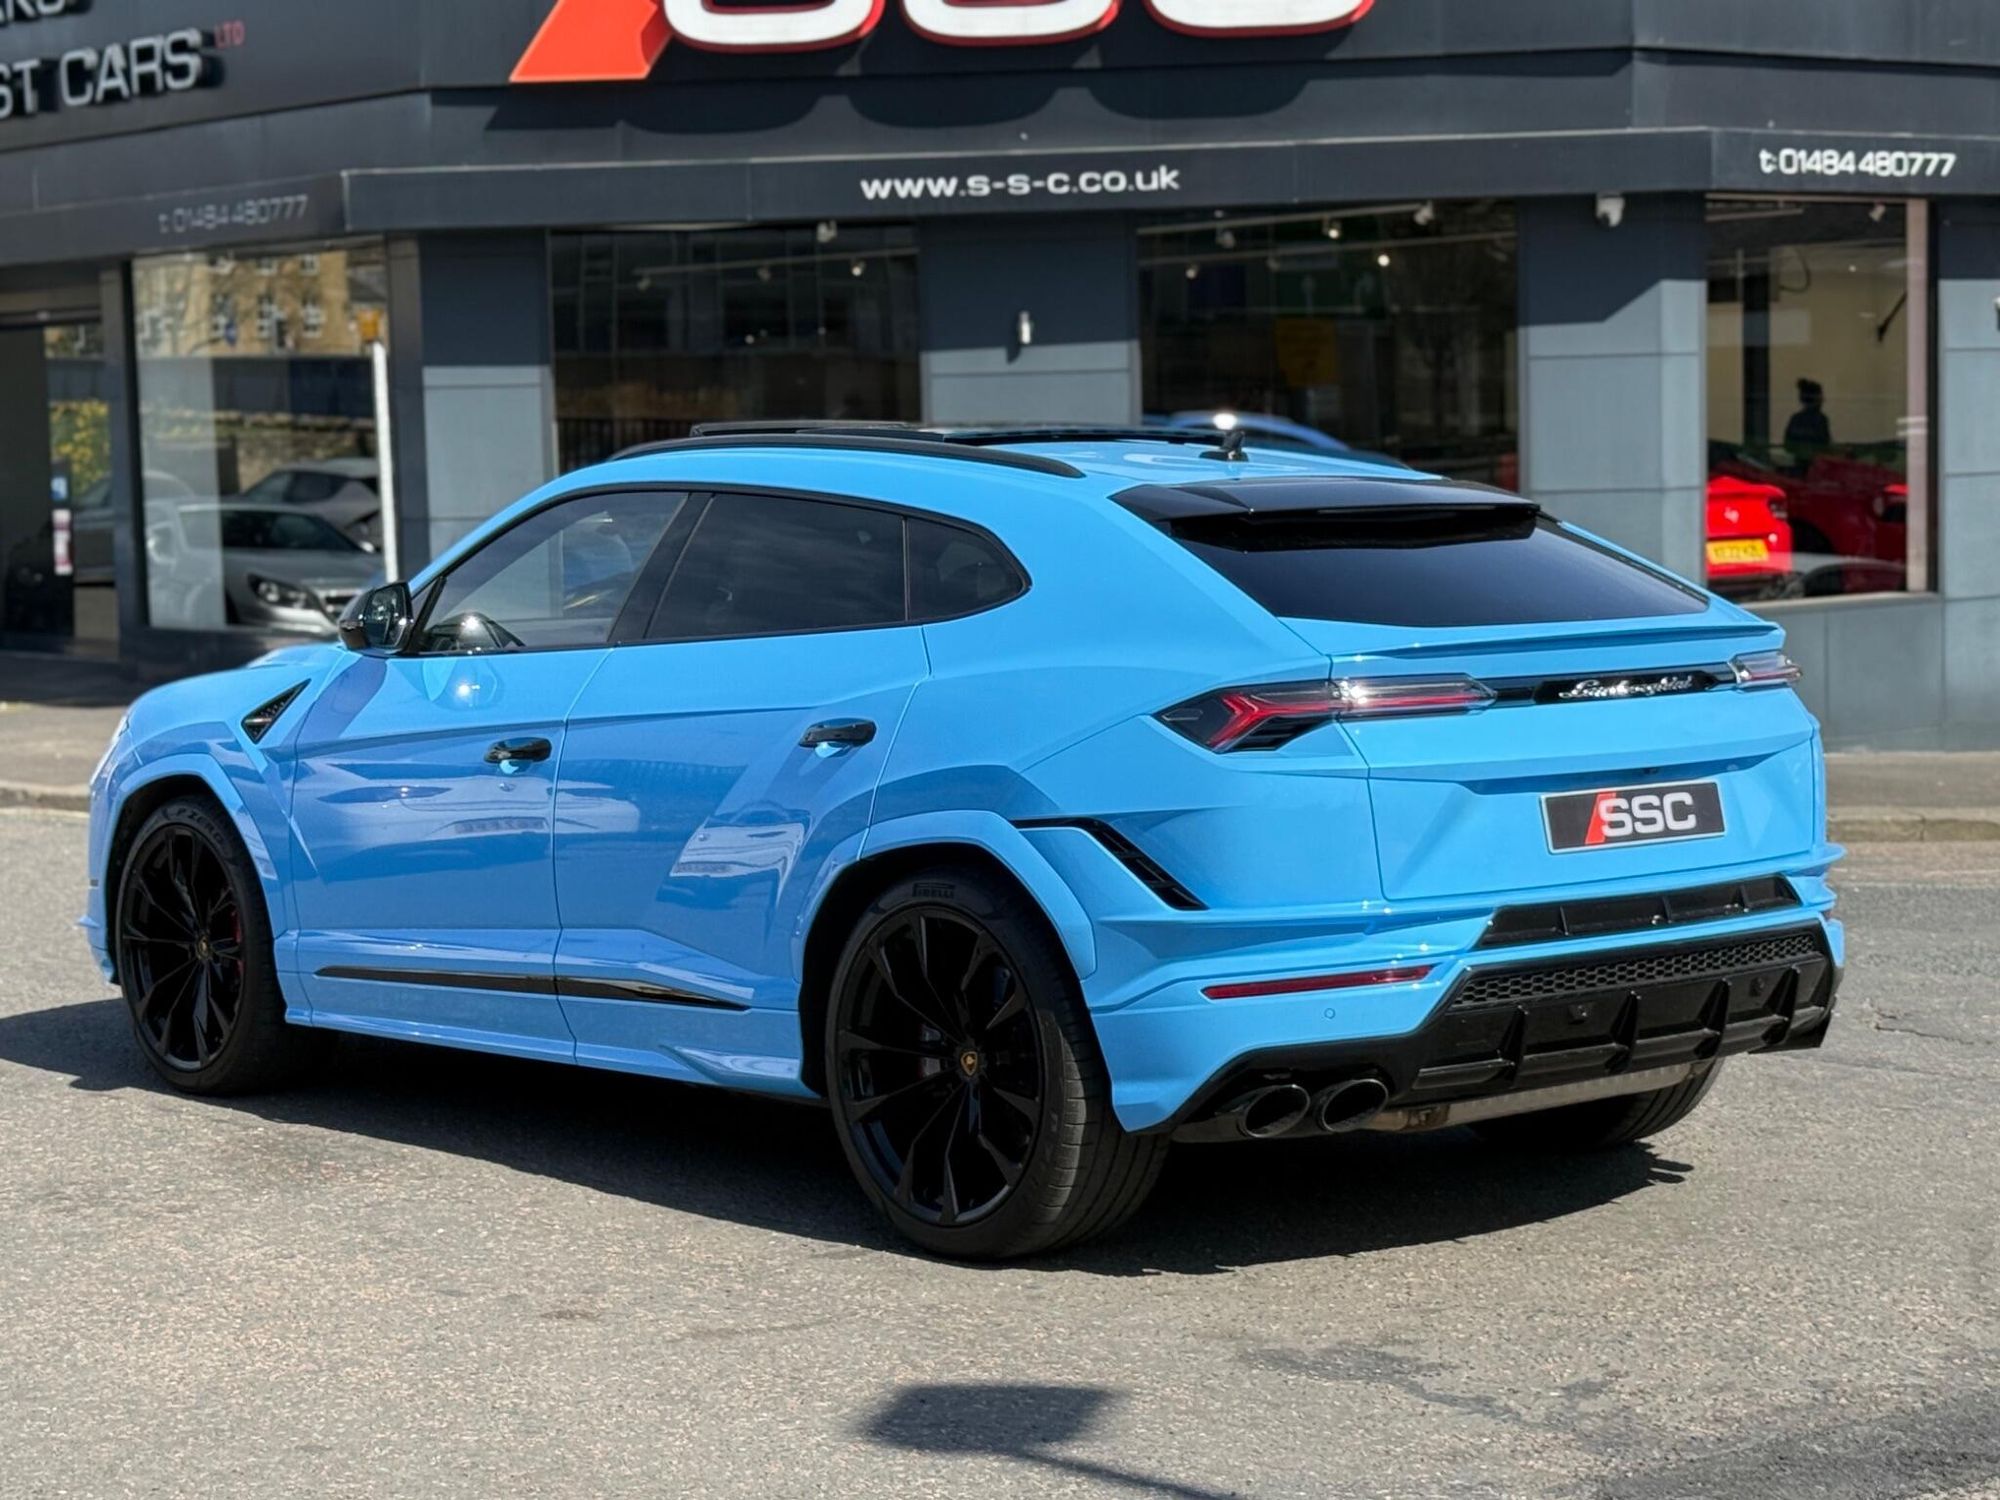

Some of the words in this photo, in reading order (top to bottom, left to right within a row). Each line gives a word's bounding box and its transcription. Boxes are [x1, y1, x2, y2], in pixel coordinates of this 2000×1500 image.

[60, 28, 201, 107] CARS
[214, 21, 245, 47] LTD
[860, 165, 1181, 200] www.s-s-c.co.uk
[1600, 791, 1697, 839] SSC
[912, 882, 955, 898] PIRELLI
